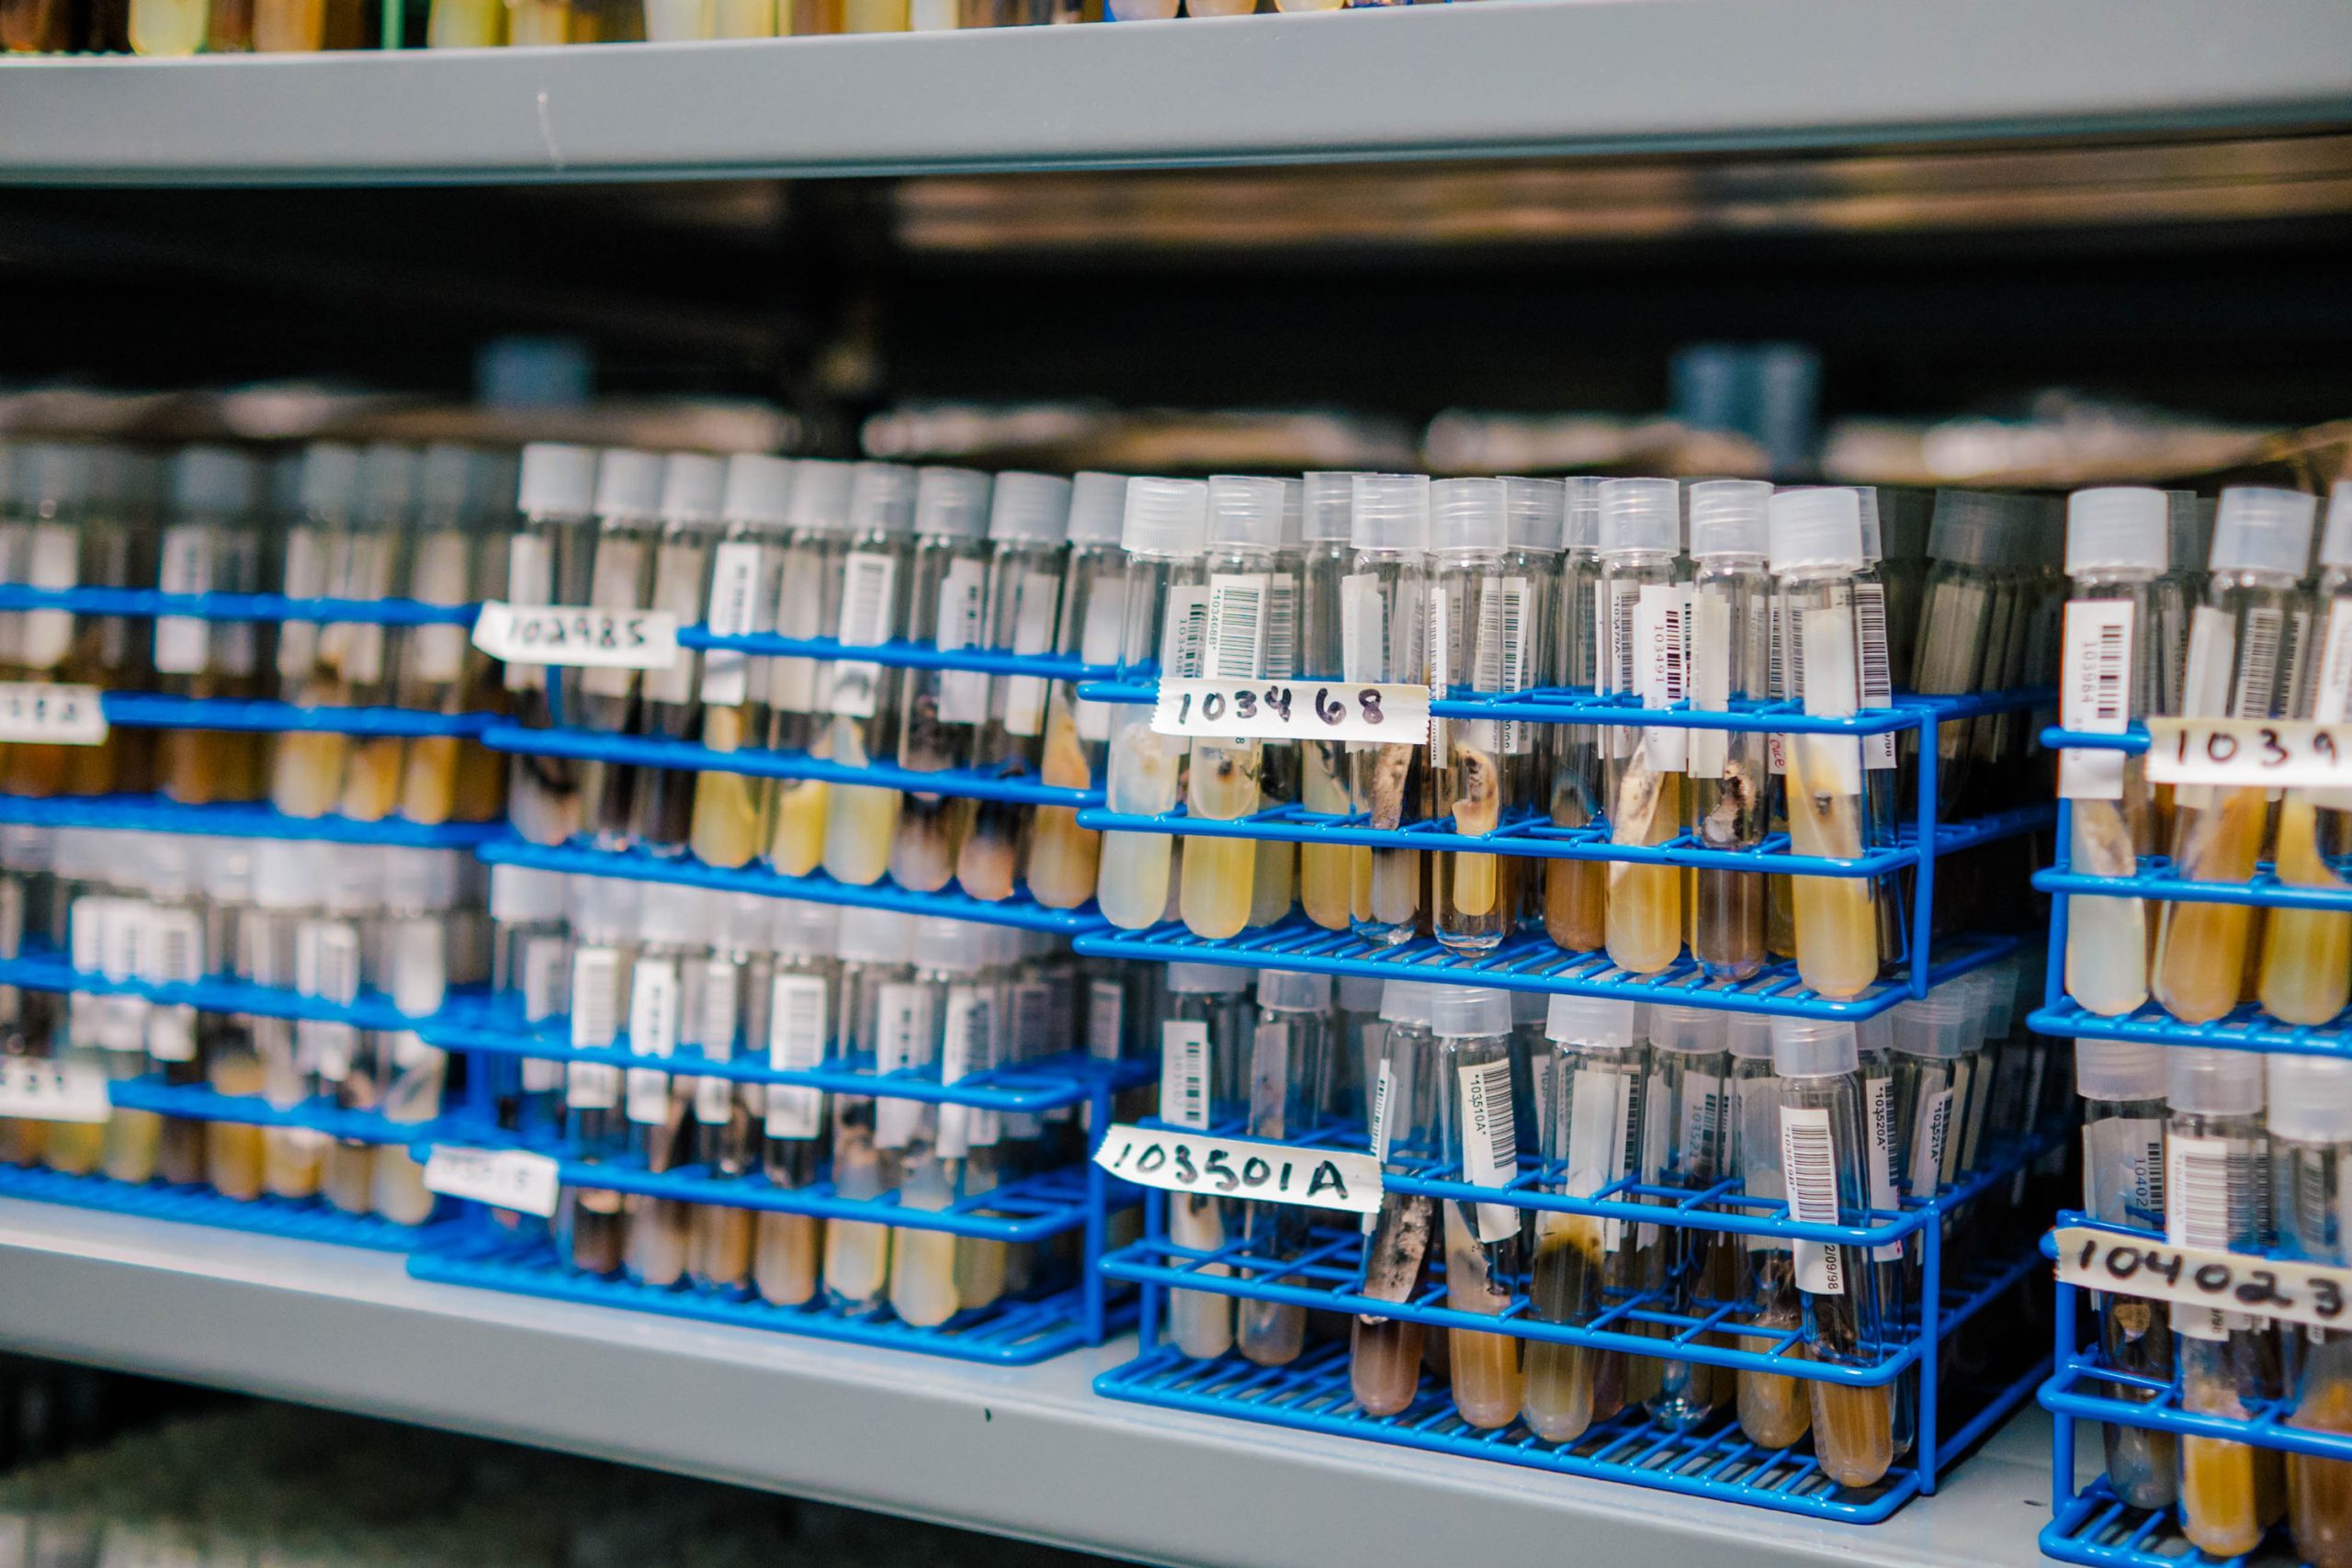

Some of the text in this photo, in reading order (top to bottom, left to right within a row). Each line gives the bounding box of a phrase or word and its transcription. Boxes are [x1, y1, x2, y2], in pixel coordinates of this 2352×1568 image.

[1653, 624, 1666, 684] 103491
[2080, 640, 2098, 705] 103984
[1690, 1105, 1703, 1159] 103521
[2133, 1157, 2150, 1214] 10402
[2079, 1239, 2346, 1319] 104023
